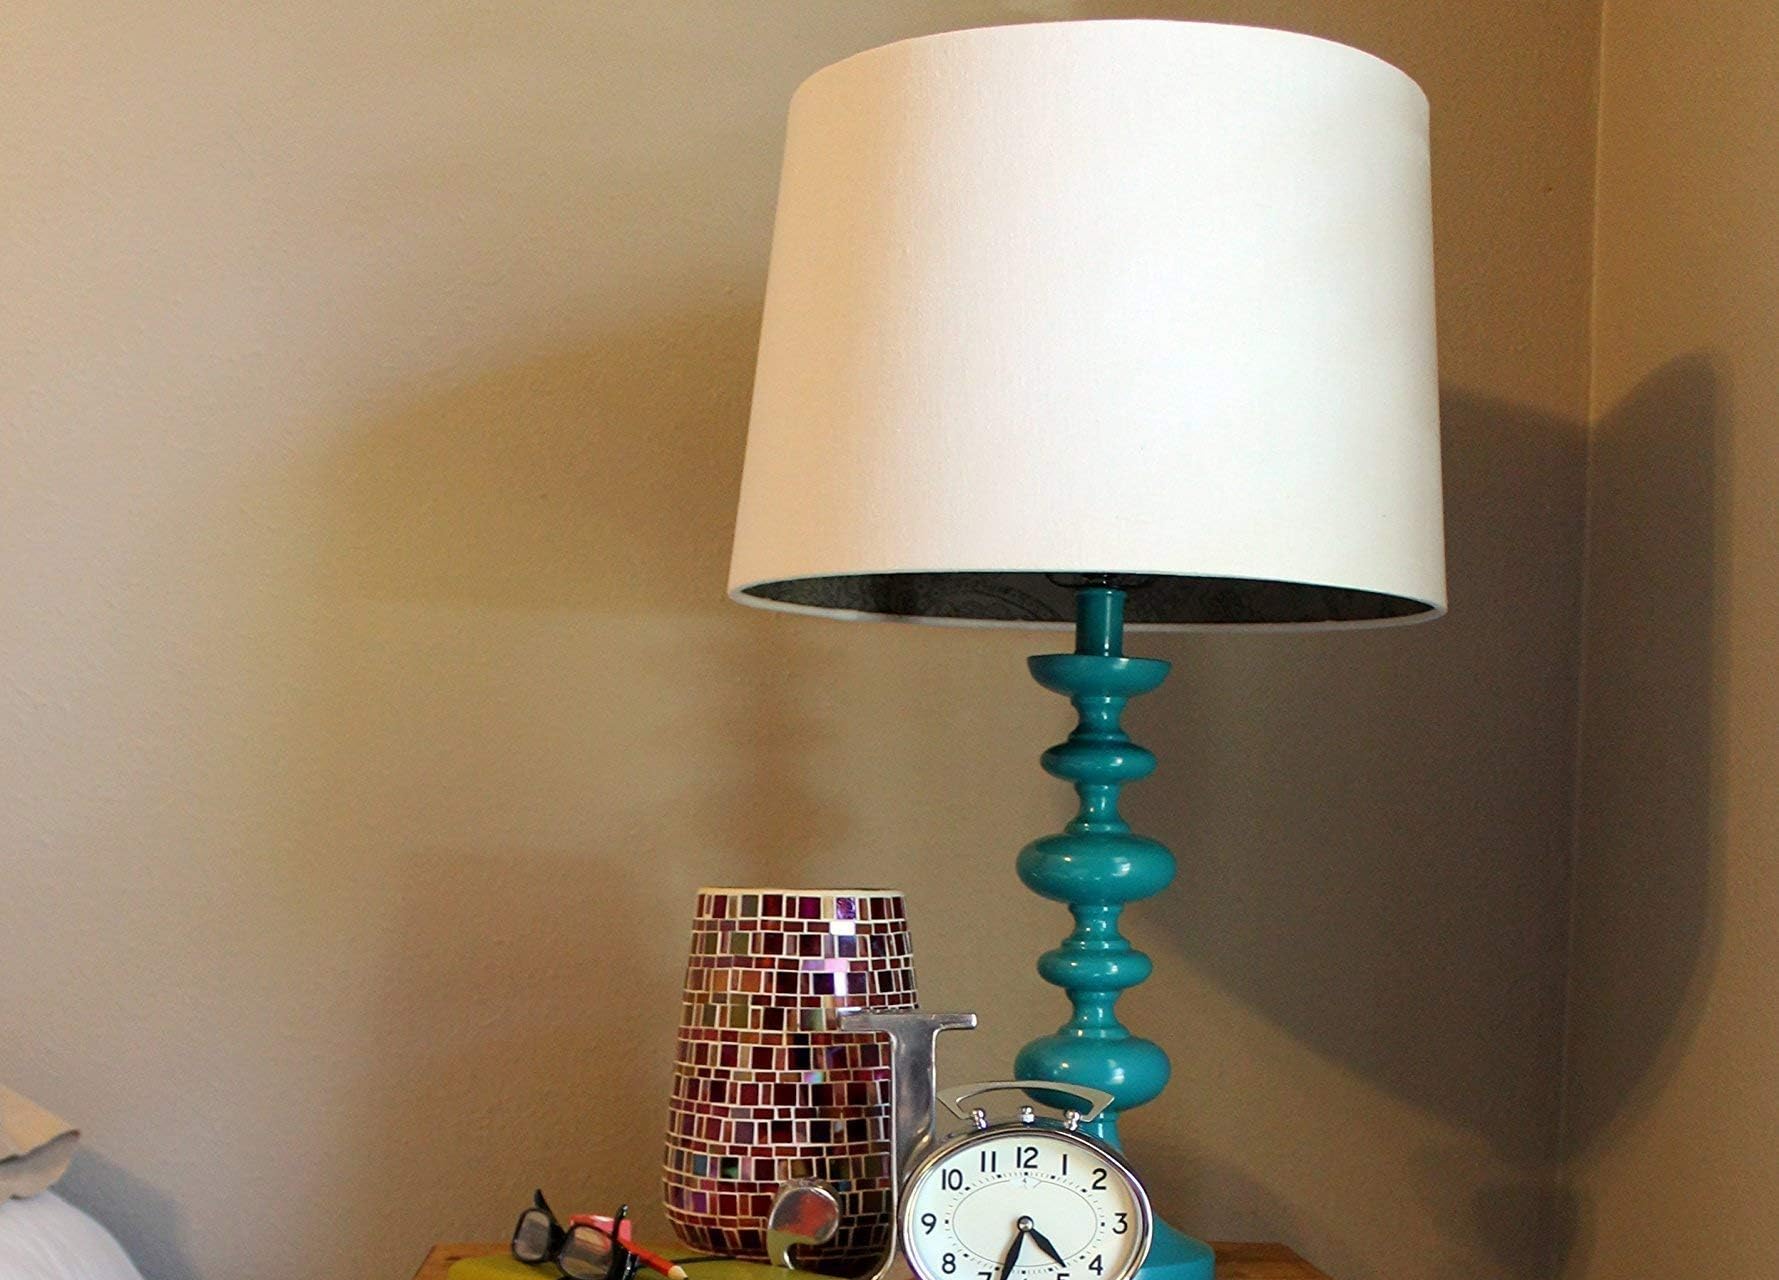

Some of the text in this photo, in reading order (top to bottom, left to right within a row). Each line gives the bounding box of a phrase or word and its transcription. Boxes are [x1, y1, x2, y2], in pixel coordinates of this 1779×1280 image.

[980, 1151, 997, 1173] 11
[1016, 1146, 1039, 1169] 12
[1062, 1153, 1068, 1176] 1
[941, 1168, 963, 1191] 10
[1091, 1167, 1108, 1190] 2
[920, 1212, 937, 1235] 9
[1112, 1212, 1128, 1234] 3
[941, 1252, 957, 1274] 8
[1088, 1254, 1103, 1276] 4
